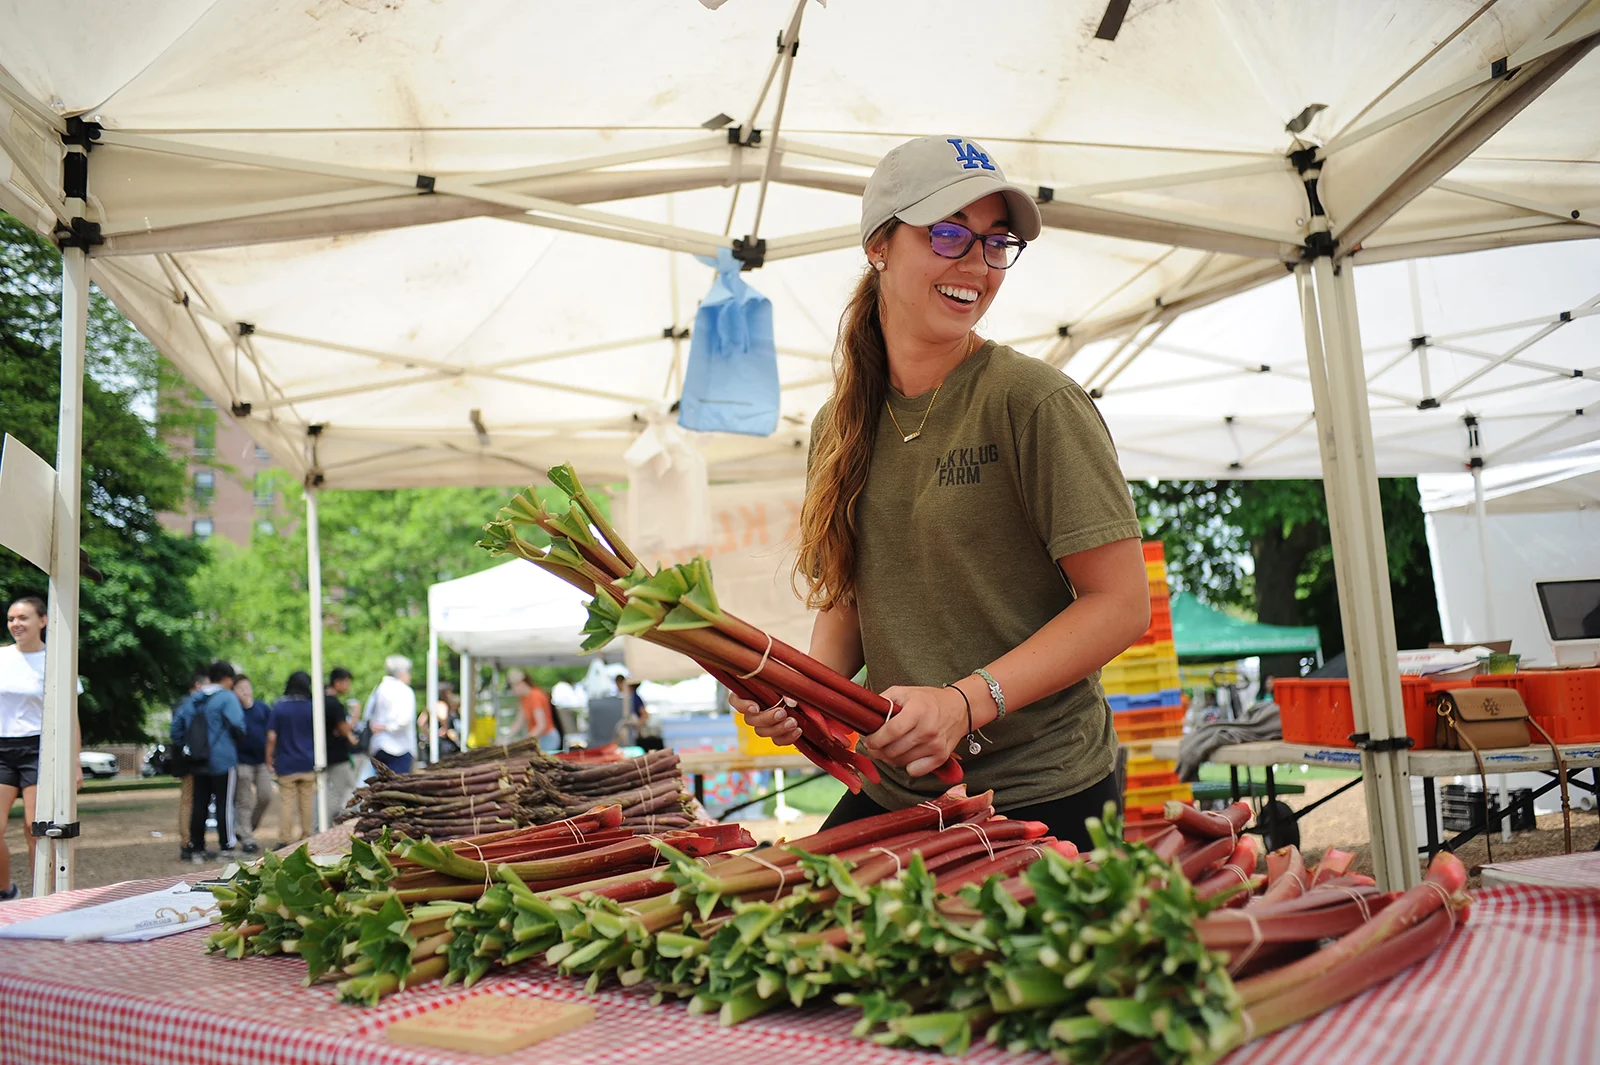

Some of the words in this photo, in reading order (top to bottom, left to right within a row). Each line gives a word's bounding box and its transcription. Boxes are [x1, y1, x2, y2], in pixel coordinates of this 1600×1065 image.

[946, 139, 995, 171] LA
[959, 444, 999, 467] KLUG
[938, 466, 980, 487] FARM
